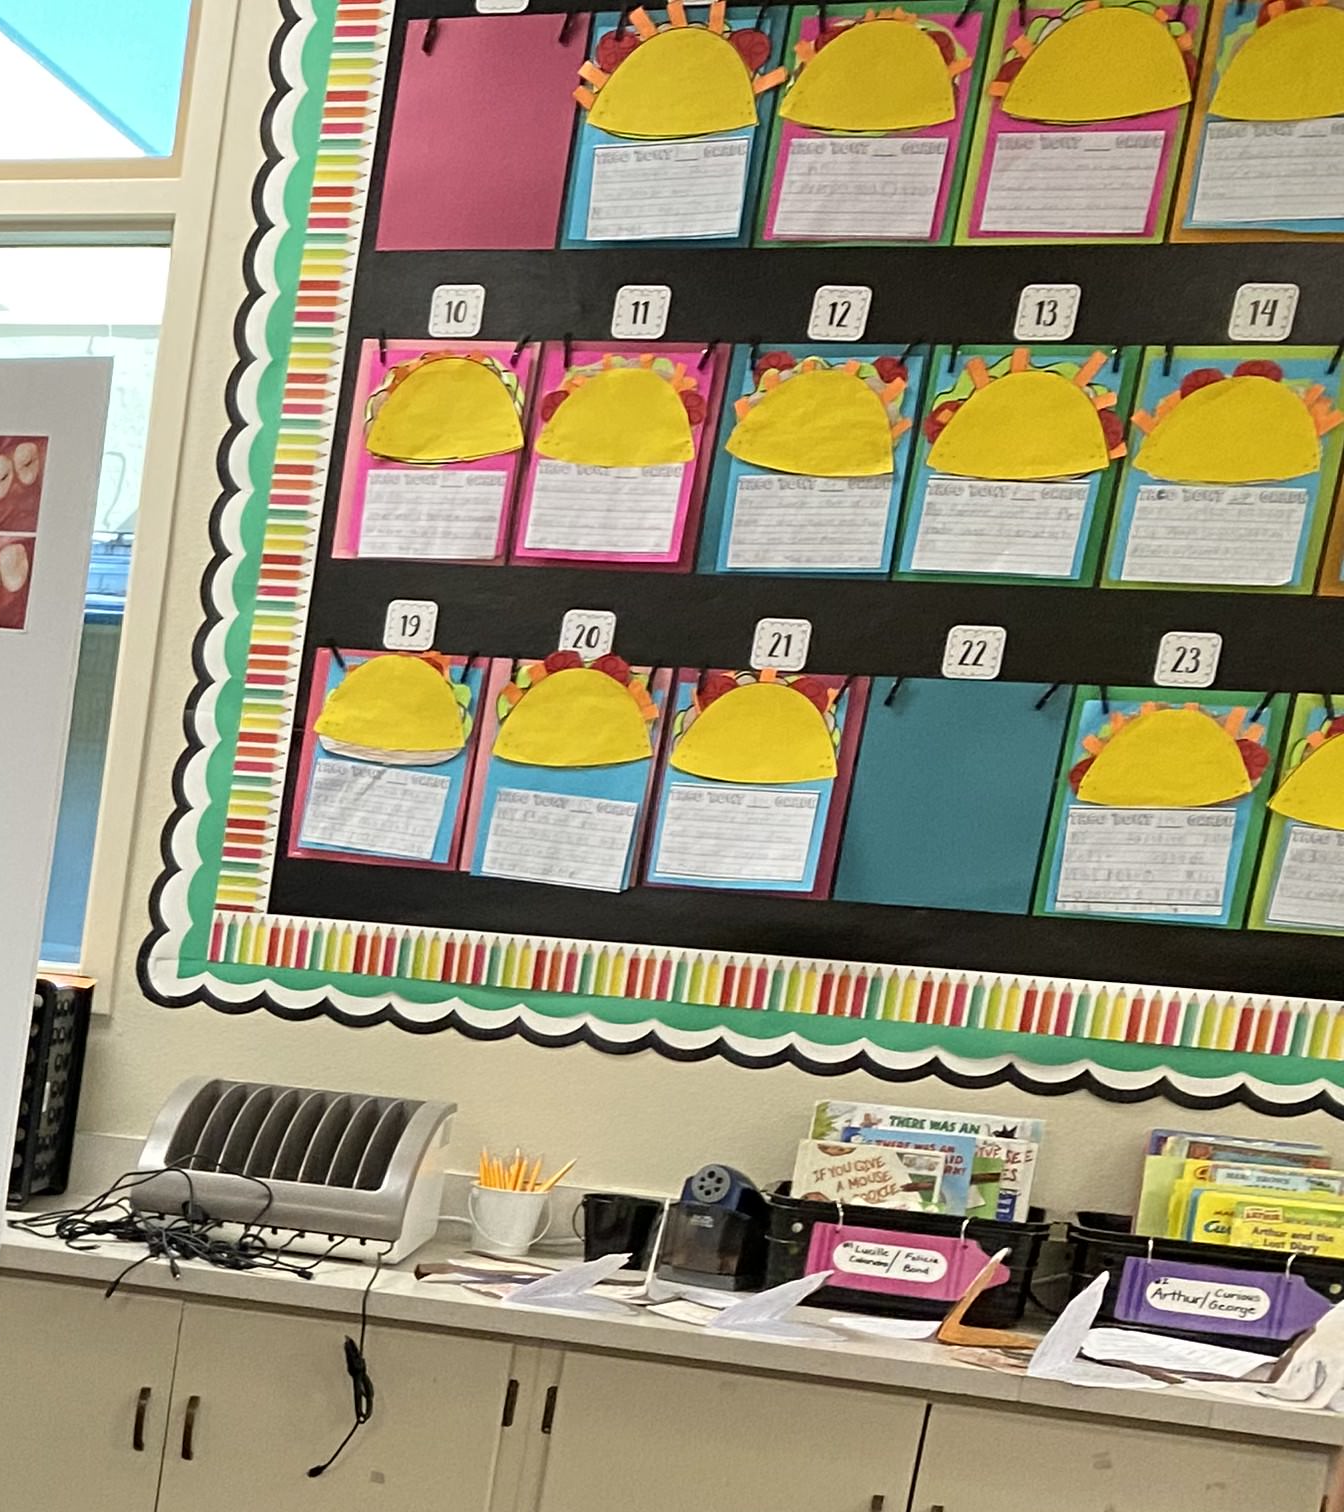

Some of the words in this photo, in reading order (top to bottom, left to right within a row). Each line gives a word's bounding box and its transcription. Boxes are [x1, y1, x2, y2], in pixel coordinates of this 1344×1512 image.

[443, 300, 467, 325] 10
[630, 300, 650, 325] 11
[827, 300, 851, 328] 12
[1034, 299, 1058, 327] 13
[1248, 299, 1278, 327] 14
[399, 614, 421, 638] 19
[572, 624, 600, 649] 20
[767, 633, 792, 658] 21
[958, 639, 986, 666] 22
[1170, 647, 1201, 674] 23
[889, 1115, 926, 1130] THERE
[929, 1120, 957, 1132] WAS
[958, 1122, 980, 1134] AN
[813, 1167, 826, 1183] IF
[828, 1161, 852, 1178] YOU
[854, 1156, 885, 1172] GIVE
[836, 1180, 844, 1193] A
[847, 1171, 892, 1190] MOUSE
[1252, 1226, 1287, 1238] Arthur
[1291, 1231, 1312, 1241] and
[1316, 1232, 1334, 1241] the
[1263, 1238, 1285, 1248] Lost
[1289, 1241, 1320, 1252] Diary
[855, 1245, 889, 1257] Lucille
[1215, 1289, 1261, 1302] Curious
[1208, 1301, 1256, 1319] George
